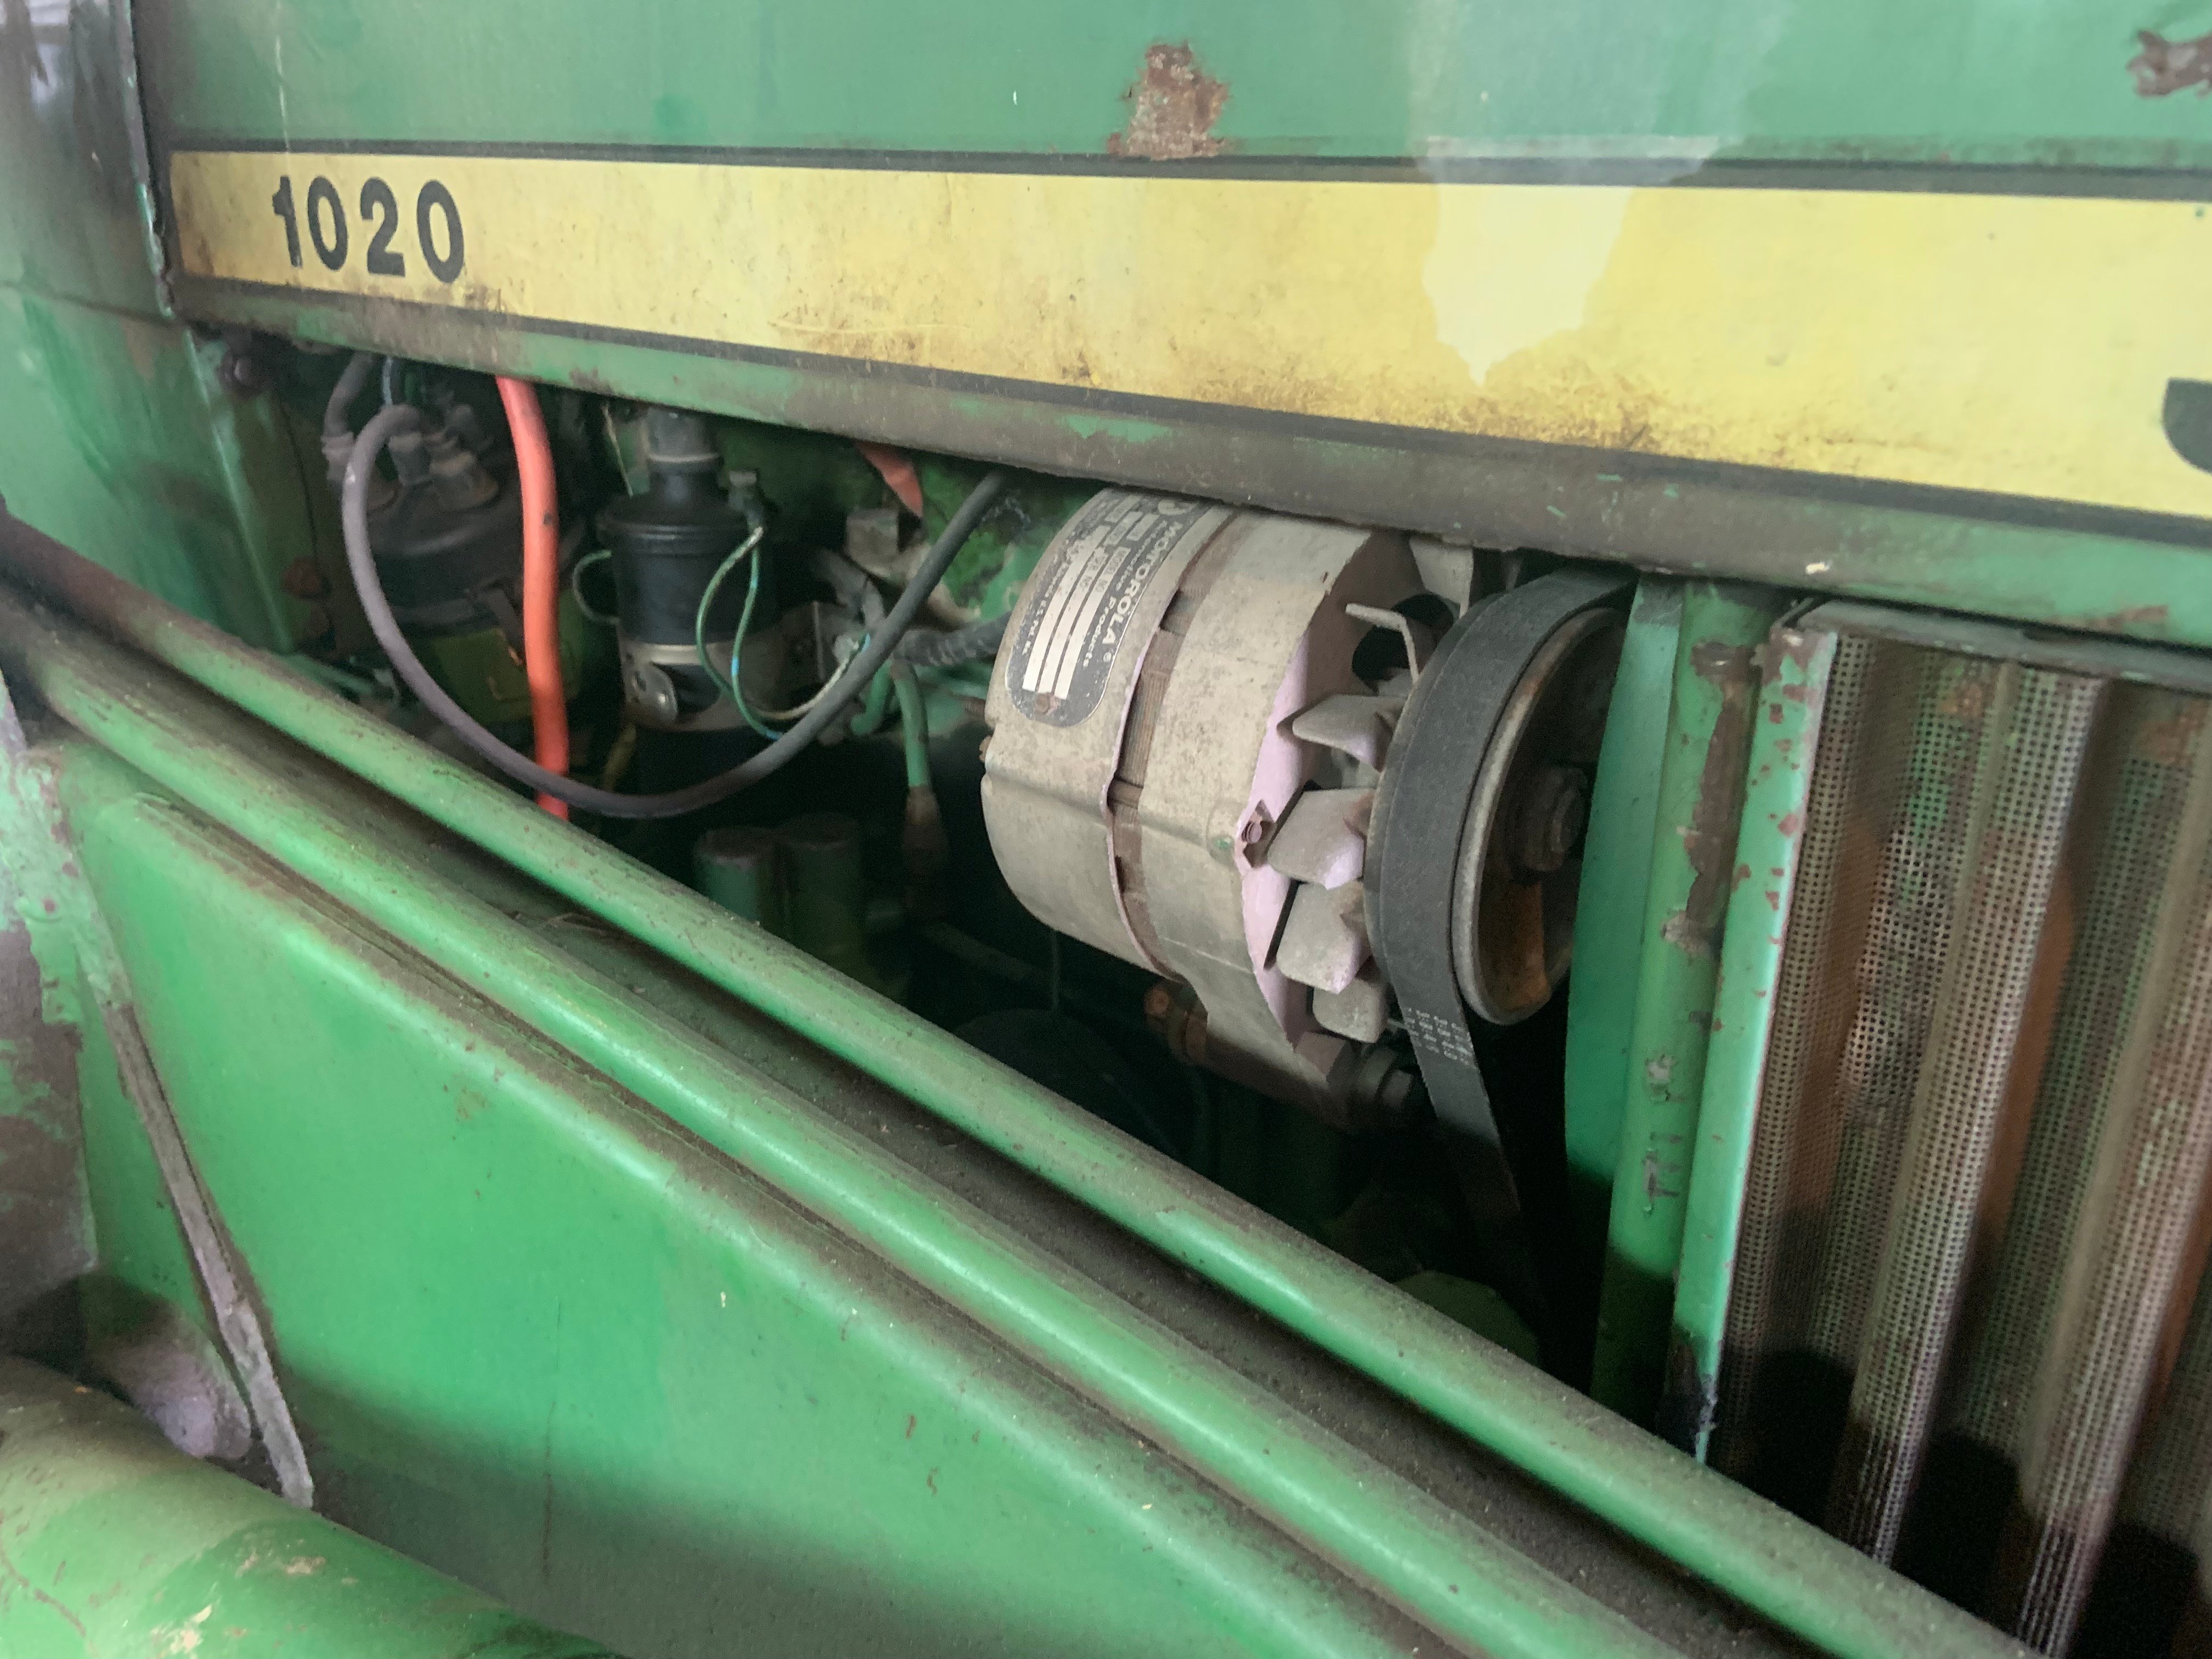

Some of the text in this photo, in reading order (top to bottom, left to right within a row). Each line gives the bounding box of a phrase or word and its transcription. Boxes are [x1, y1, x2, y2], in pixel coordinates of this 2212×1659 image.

[272, 176, 465, 284] 1020
[1082, 596, 1117, 667] Products
[1102, 521, 1183, 644] MOTOROLA
